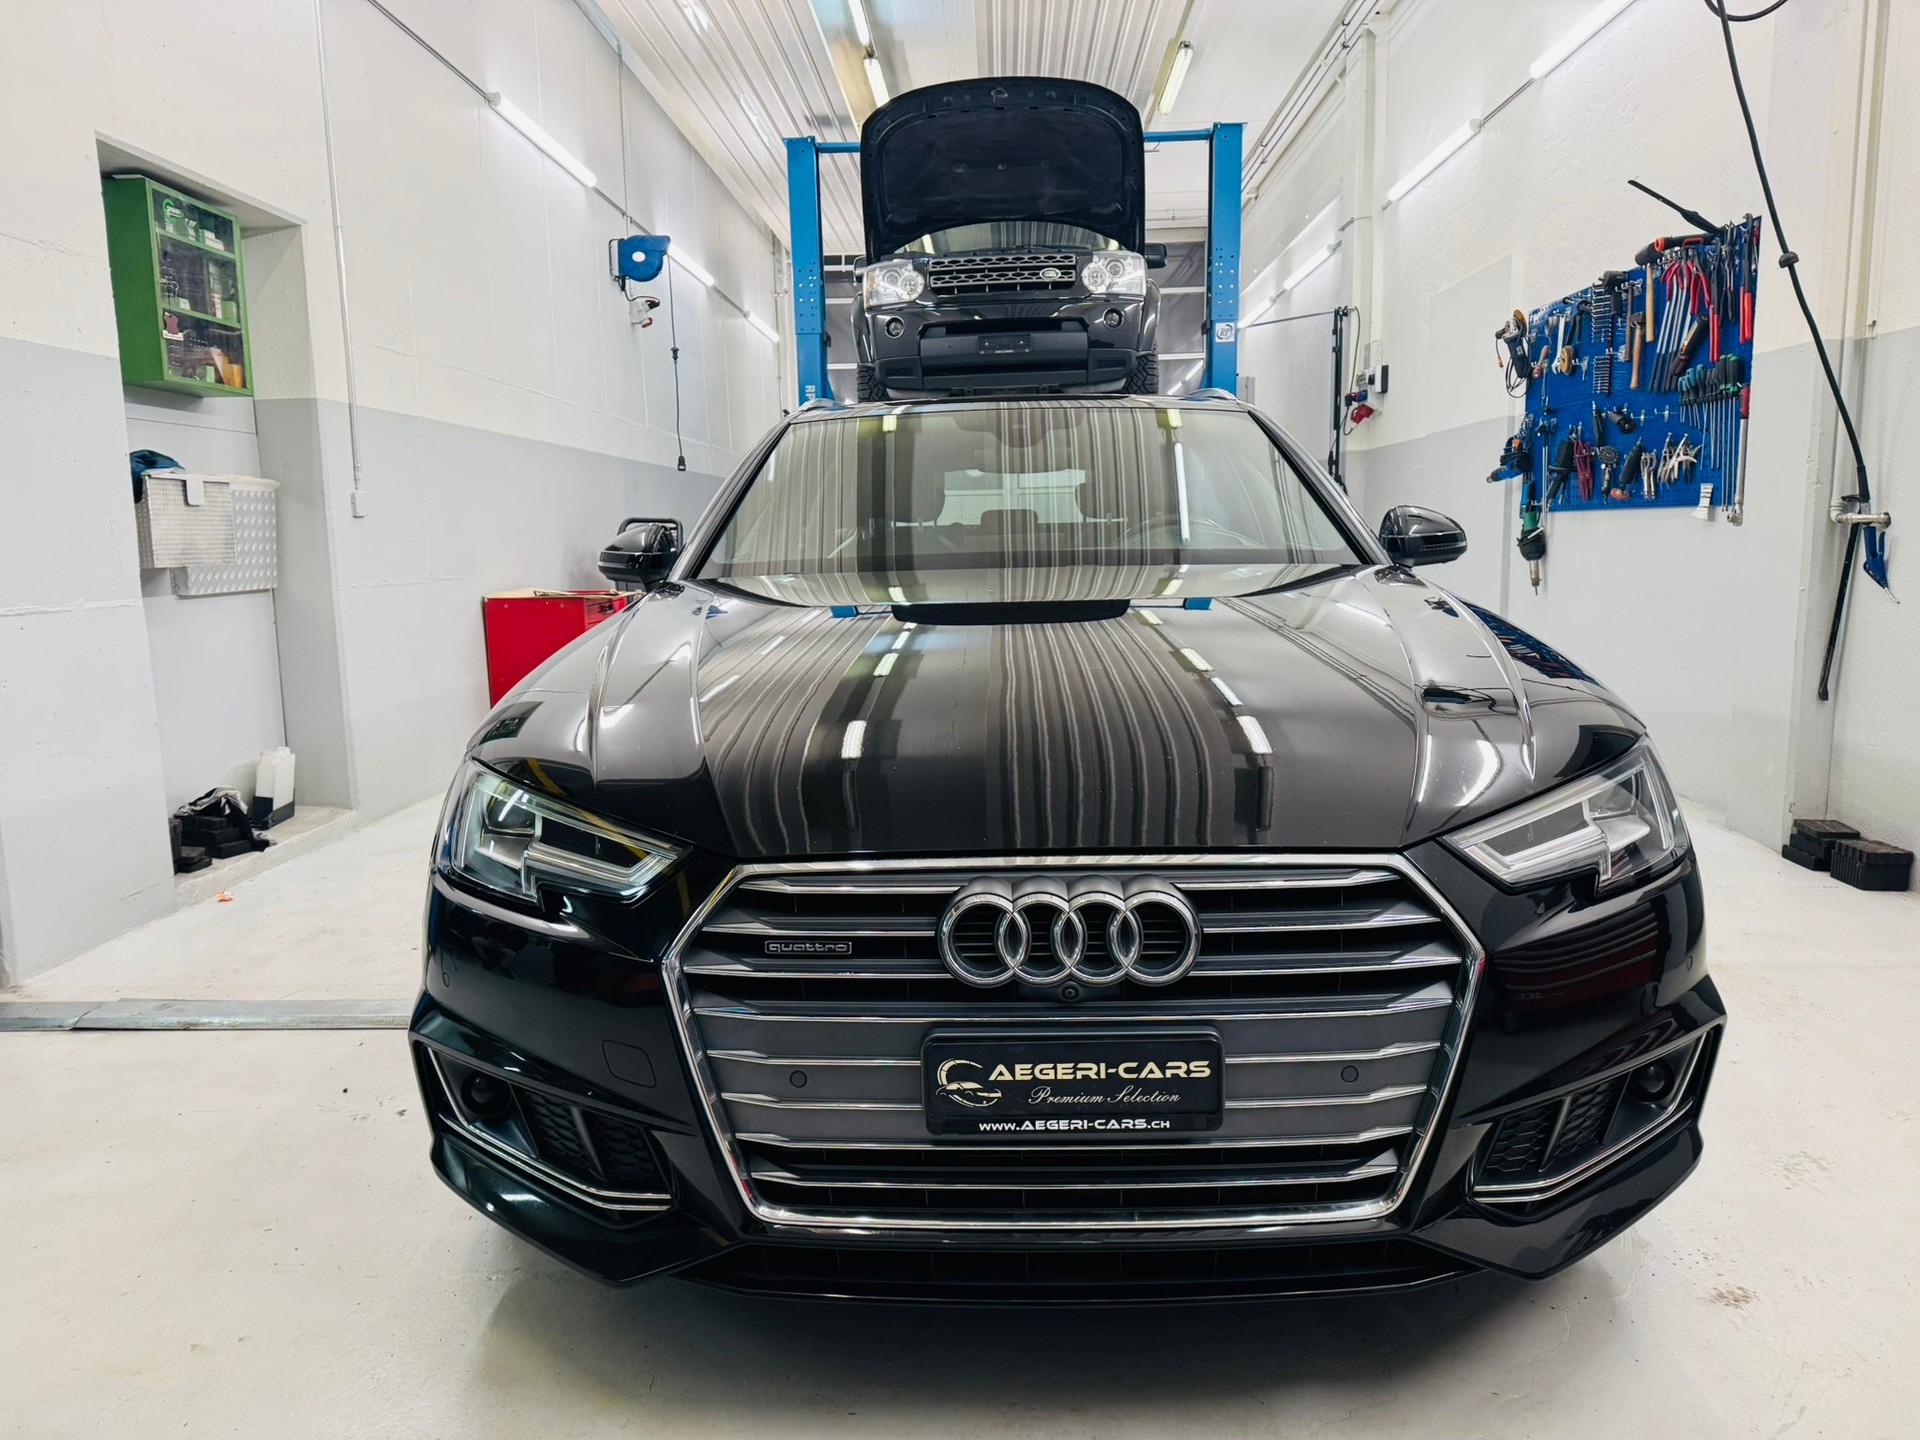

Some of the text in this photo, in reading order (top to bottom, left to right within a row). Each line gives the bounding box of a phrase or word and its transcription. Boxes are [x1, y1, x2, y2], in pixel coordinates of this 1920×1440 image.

[769, 943, 848, 953] quattro
[988, 1060, 1212, 1081] AEGERI-CARS
[1028, 1084, 1182, 1104] Premium Selection
